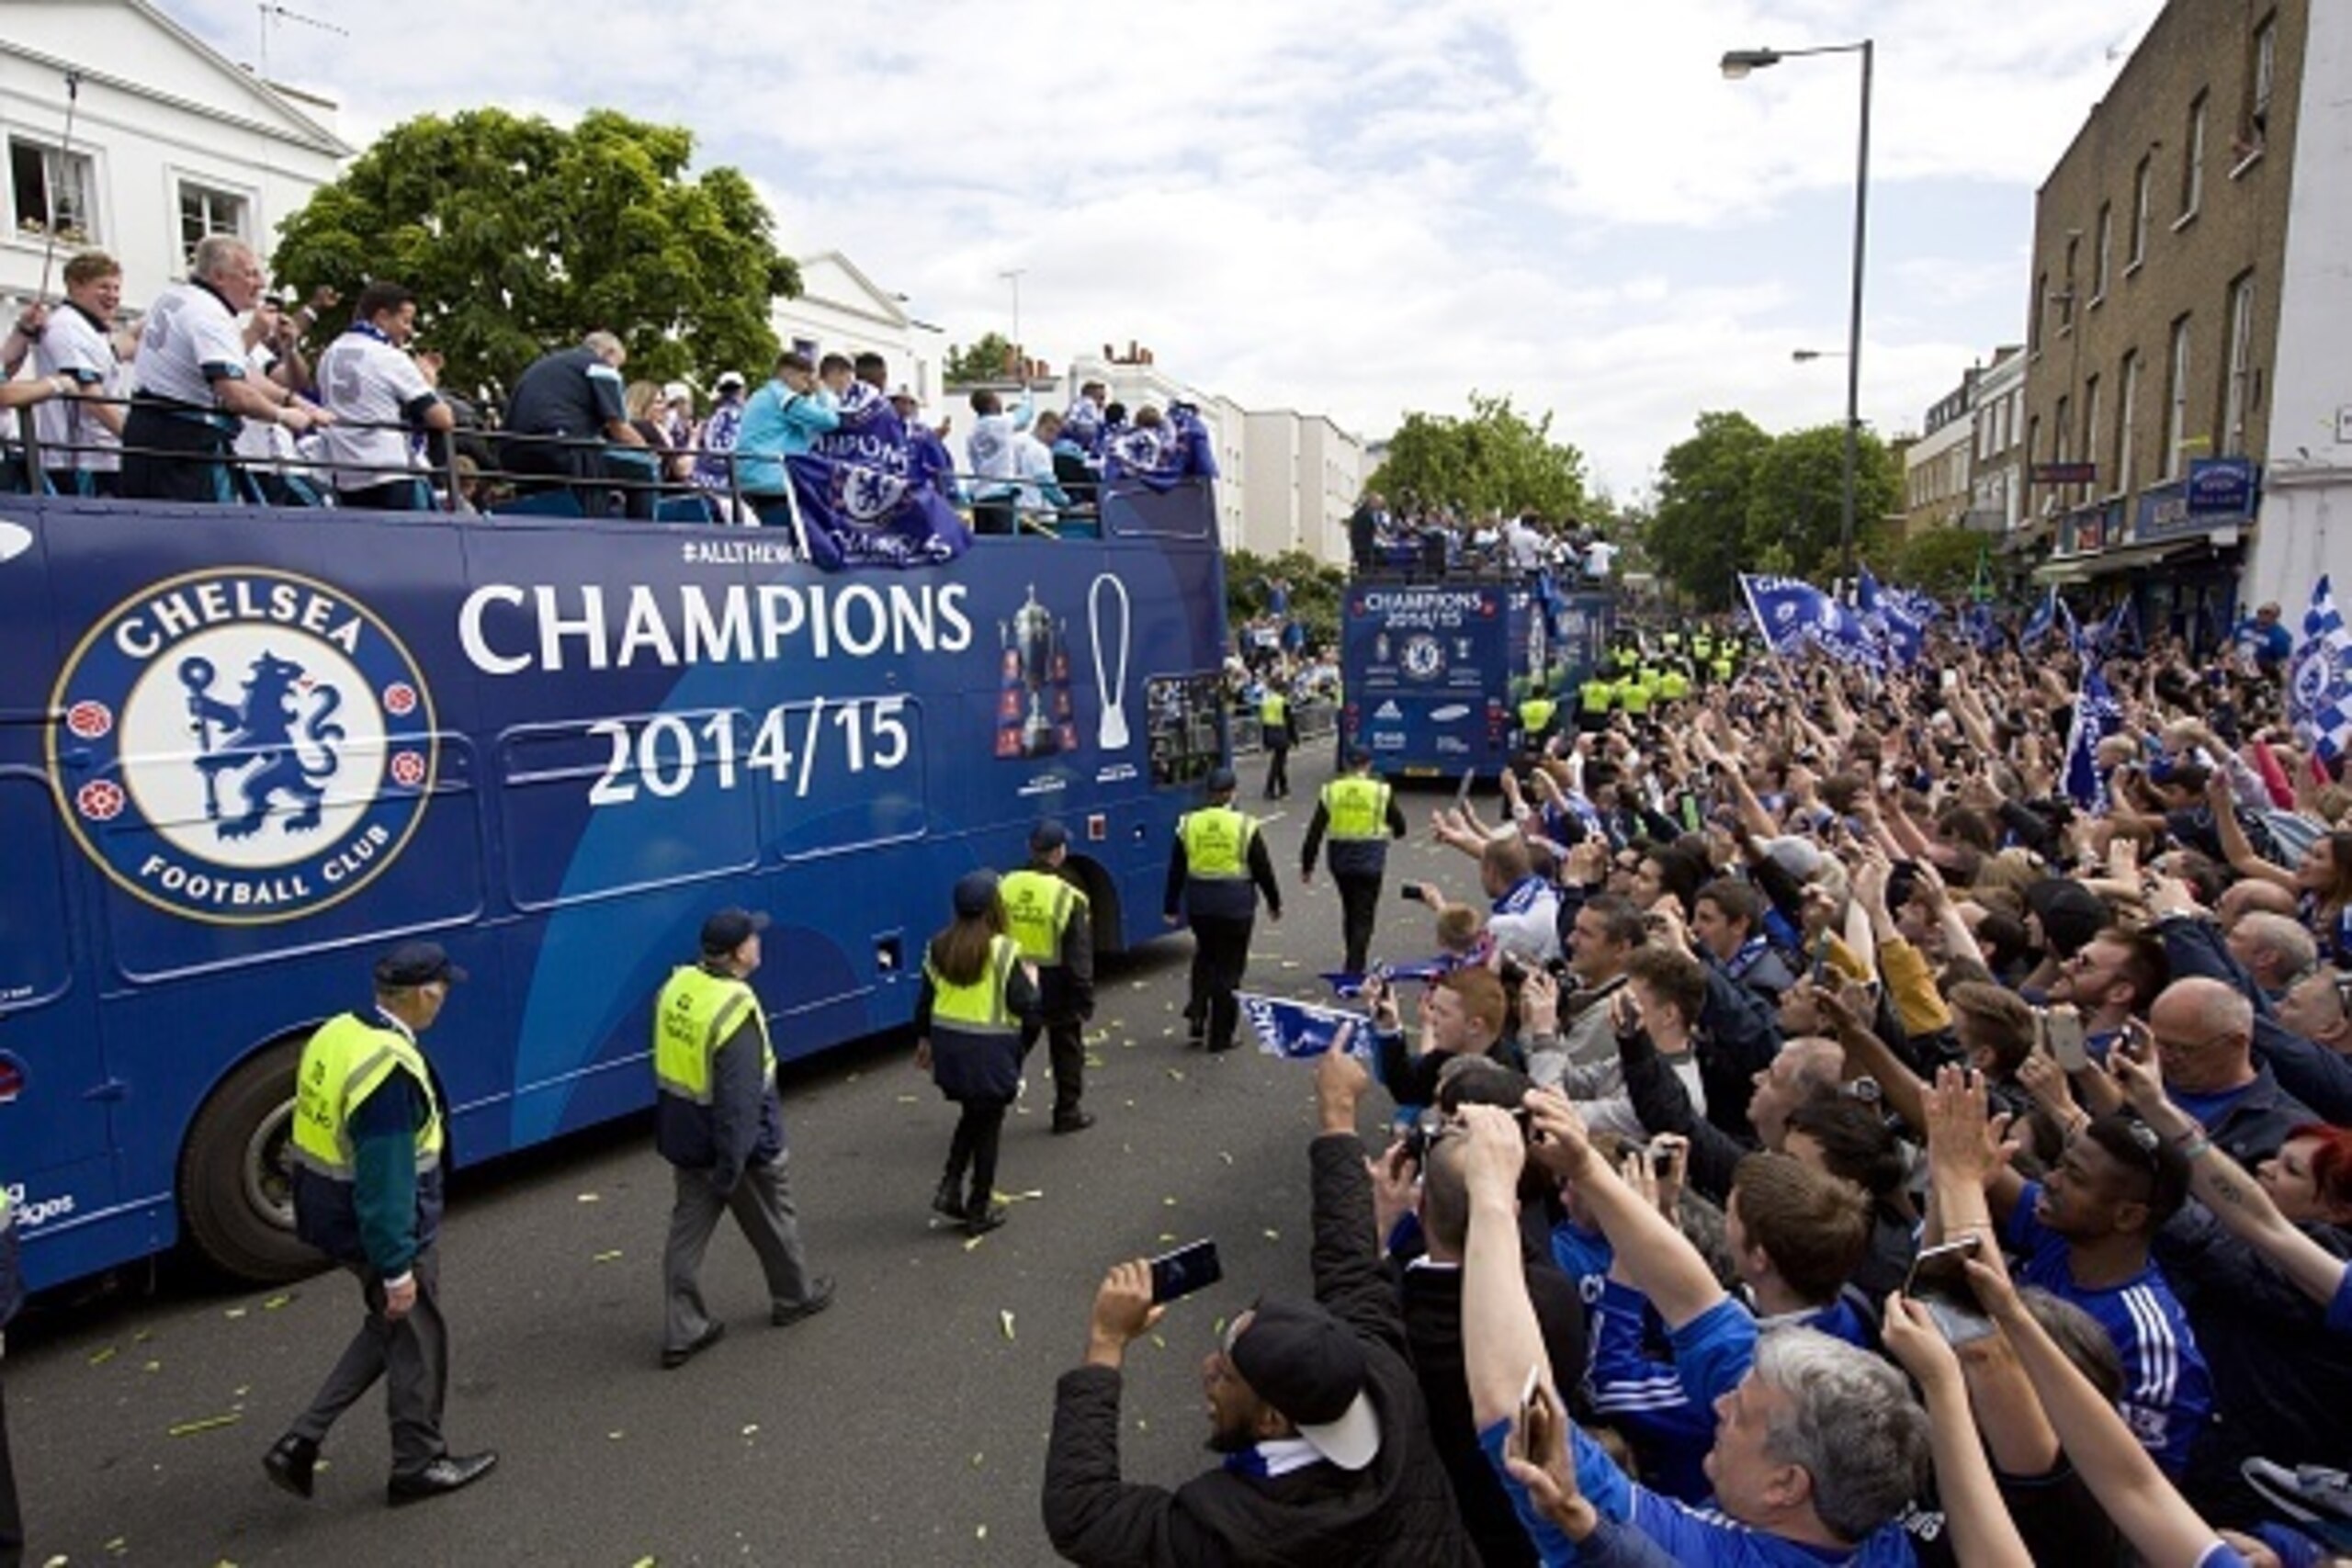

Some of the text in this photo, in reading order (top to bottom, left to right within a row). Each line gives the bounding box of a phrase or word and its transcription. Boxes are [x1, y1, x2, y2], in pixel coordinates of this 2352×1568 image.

[116, 581, 362, 658] CHELSEA
[459, 583, 973, 674] CHAMPIONS
[1365, 591, 1482, 612] CHAMPIONS
[586, 696, 909, 807] 2014/15
[141, 824, 390, 905] FOOTBALL CLUB
